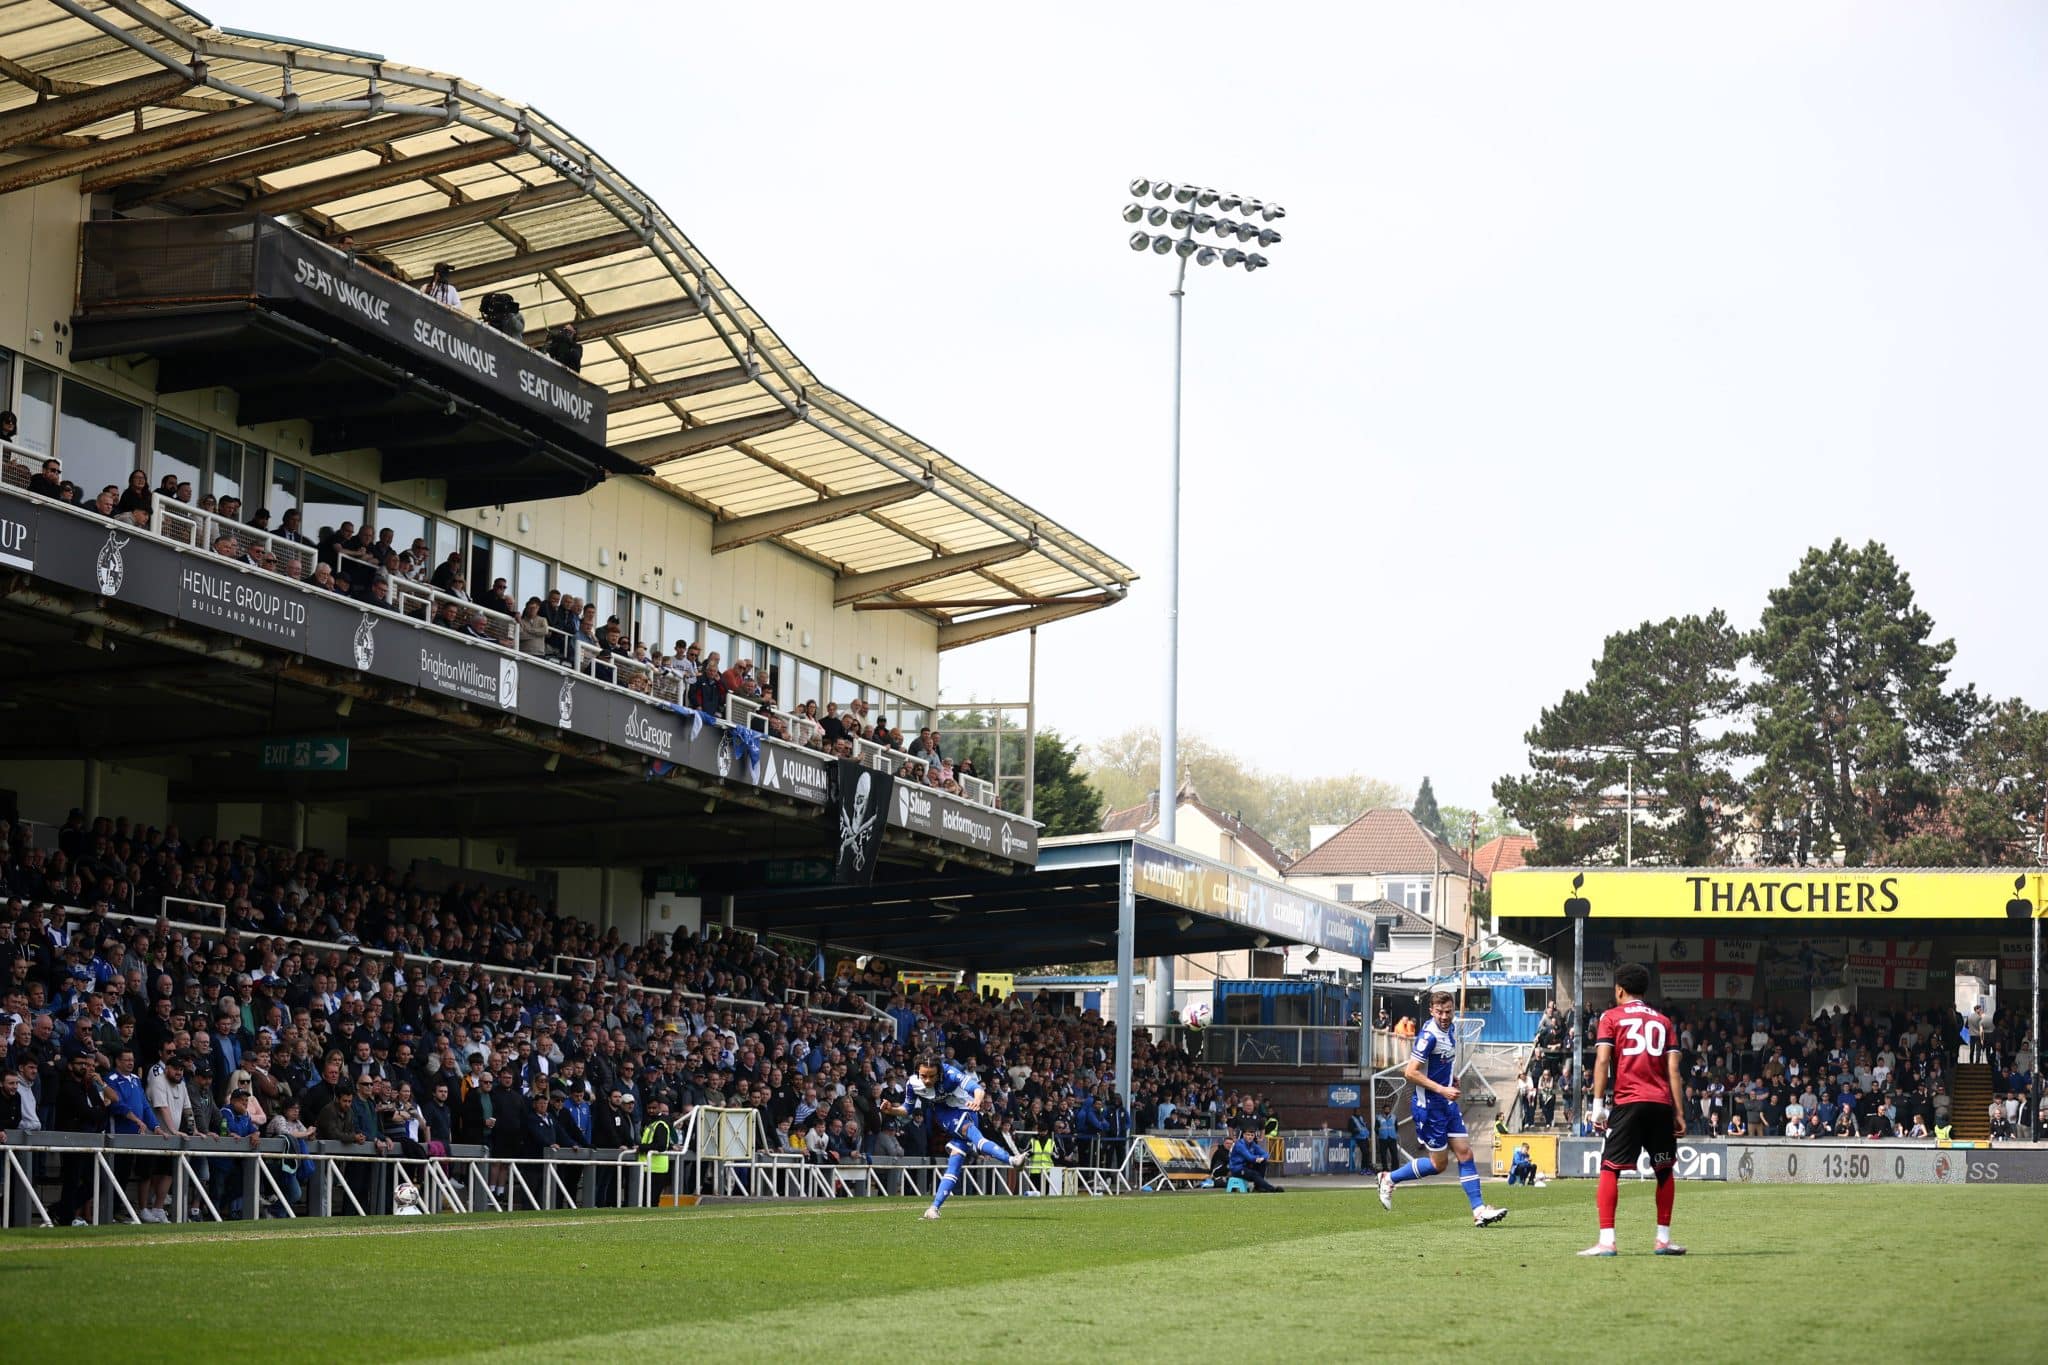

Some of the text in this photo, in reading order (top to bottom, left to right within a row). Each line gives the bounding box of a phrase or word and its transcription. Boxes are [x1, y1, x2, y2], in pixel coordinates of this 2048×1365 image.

[294, 257, 390, 326] SEAT UNIQUE
[413, 318, 498, 379] SEAT UNIQUE
[519, 369, 593, 424] SEAT UNIQUE
[183, 568, 305, 625] HENLIE GROUP LTD
[192, 599, 297, 638] BUILD AND MAINTAIN
[421, 648, 497, 692] BrightonWilliams
[264, 744, 290, 766] EXIT
[640, 718, 673, 754] Gregor
[782, 758, 827, 790] AQUARIAN
[909, 790, 931, 819] Shine
[943, 809, 992, 847] Rokformgroup
[1619, 1017, 1666, 1057] 30
[1788, 1153, 1905, 1179] 0 13:50 0
